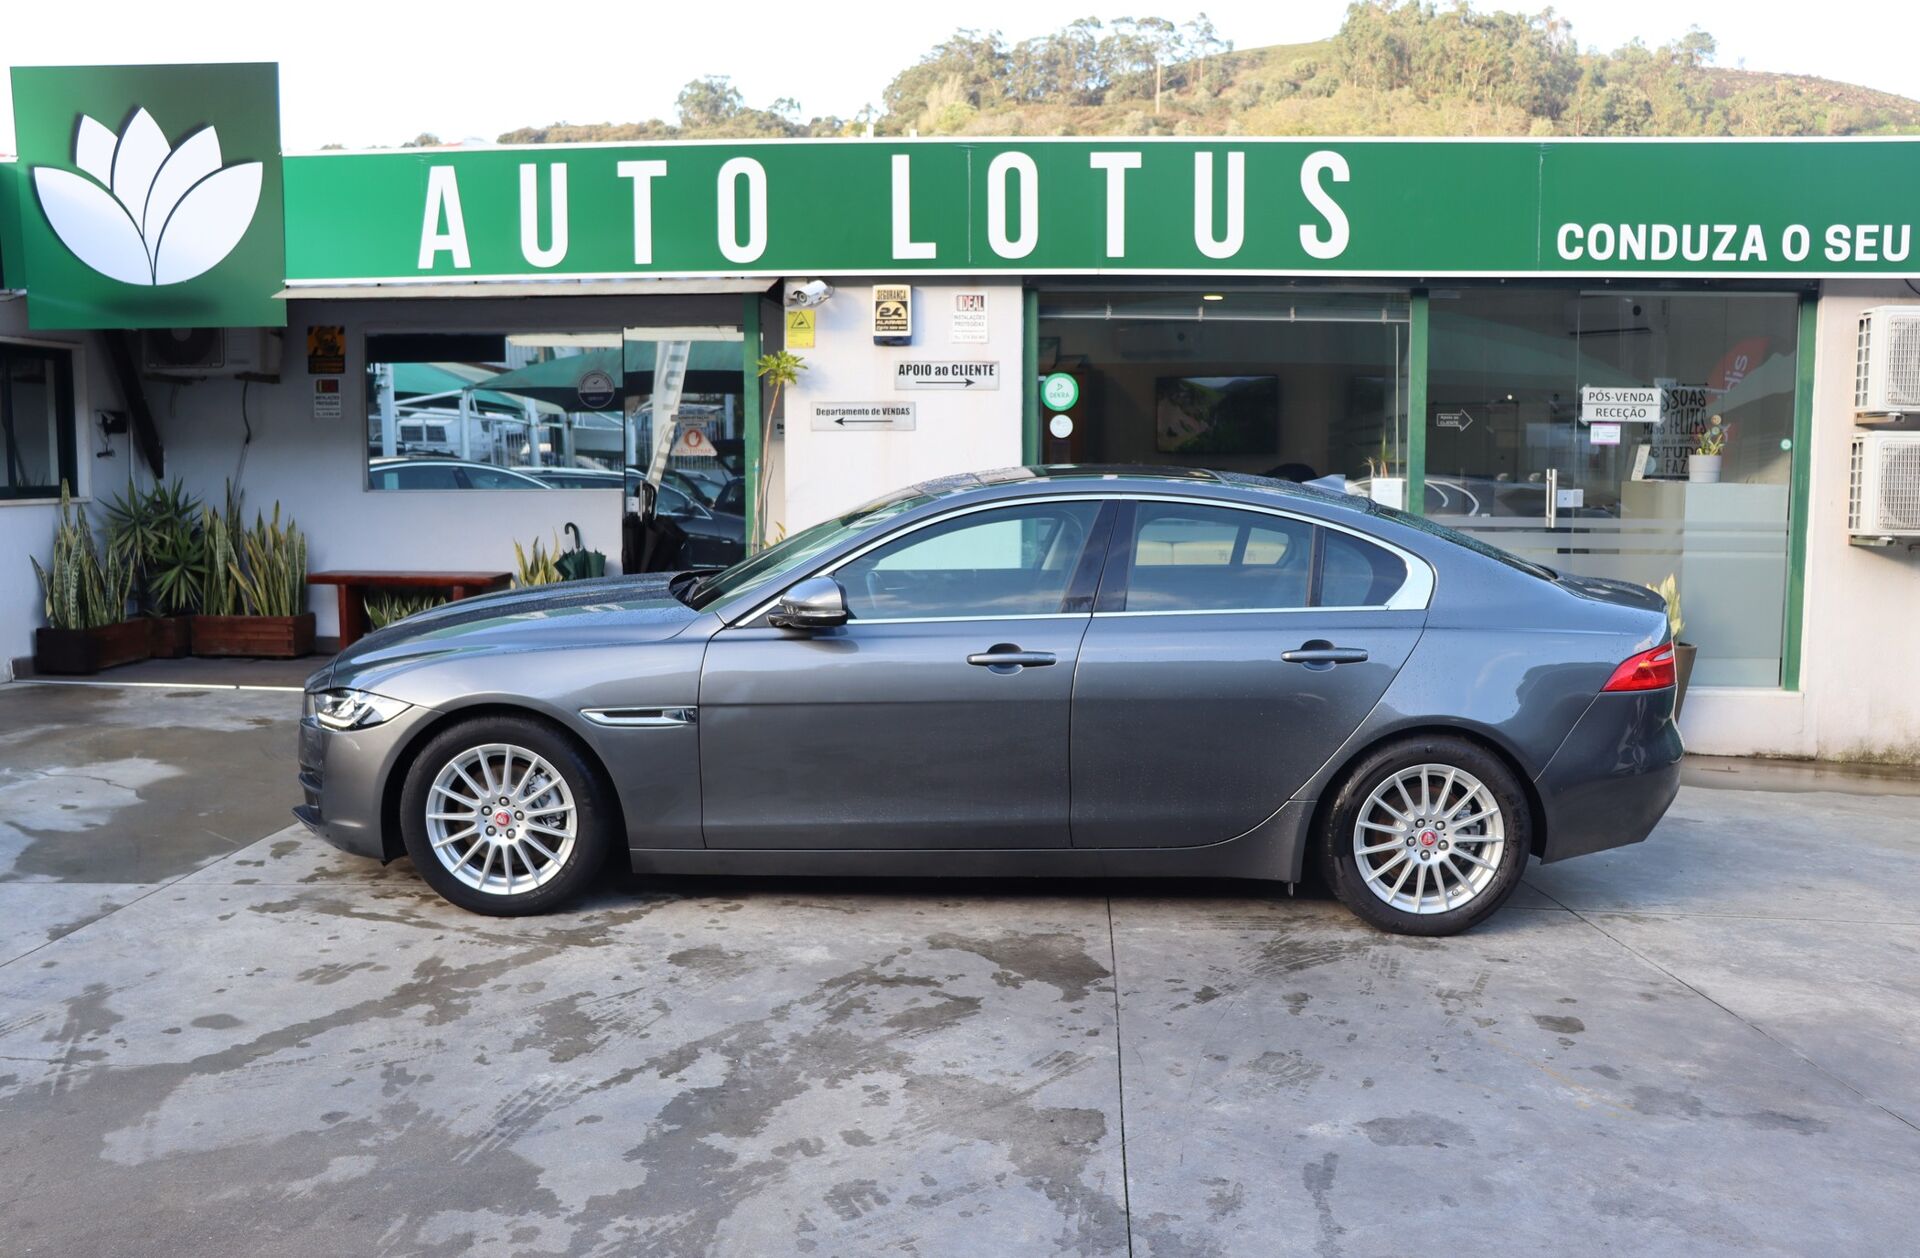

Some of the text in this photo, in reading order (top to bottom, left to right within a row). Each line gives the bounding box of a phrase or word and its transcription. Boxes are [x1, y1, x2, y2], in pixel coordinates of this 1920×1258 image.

[417, 150, 1350, 269] AUTO LOTUS
[1557, 222, 1911, 262] CONDUZA O SEU
[877, 289, 906, 300] SEGURANÇA
[956, 295, 984, 311] IDEAL
[879, 307, 902, 318] 24
[898, 364, 995, 376] APOIO ao CLIENTE
[1588, 389, 1655, 402] PÓS-VENDA
[816, 407, 911, 416] Departamento de VENDAS
[1595, 405, 1647, 420] RECEÇÃO
[1670, 408, 1707, 436] FELIZES
